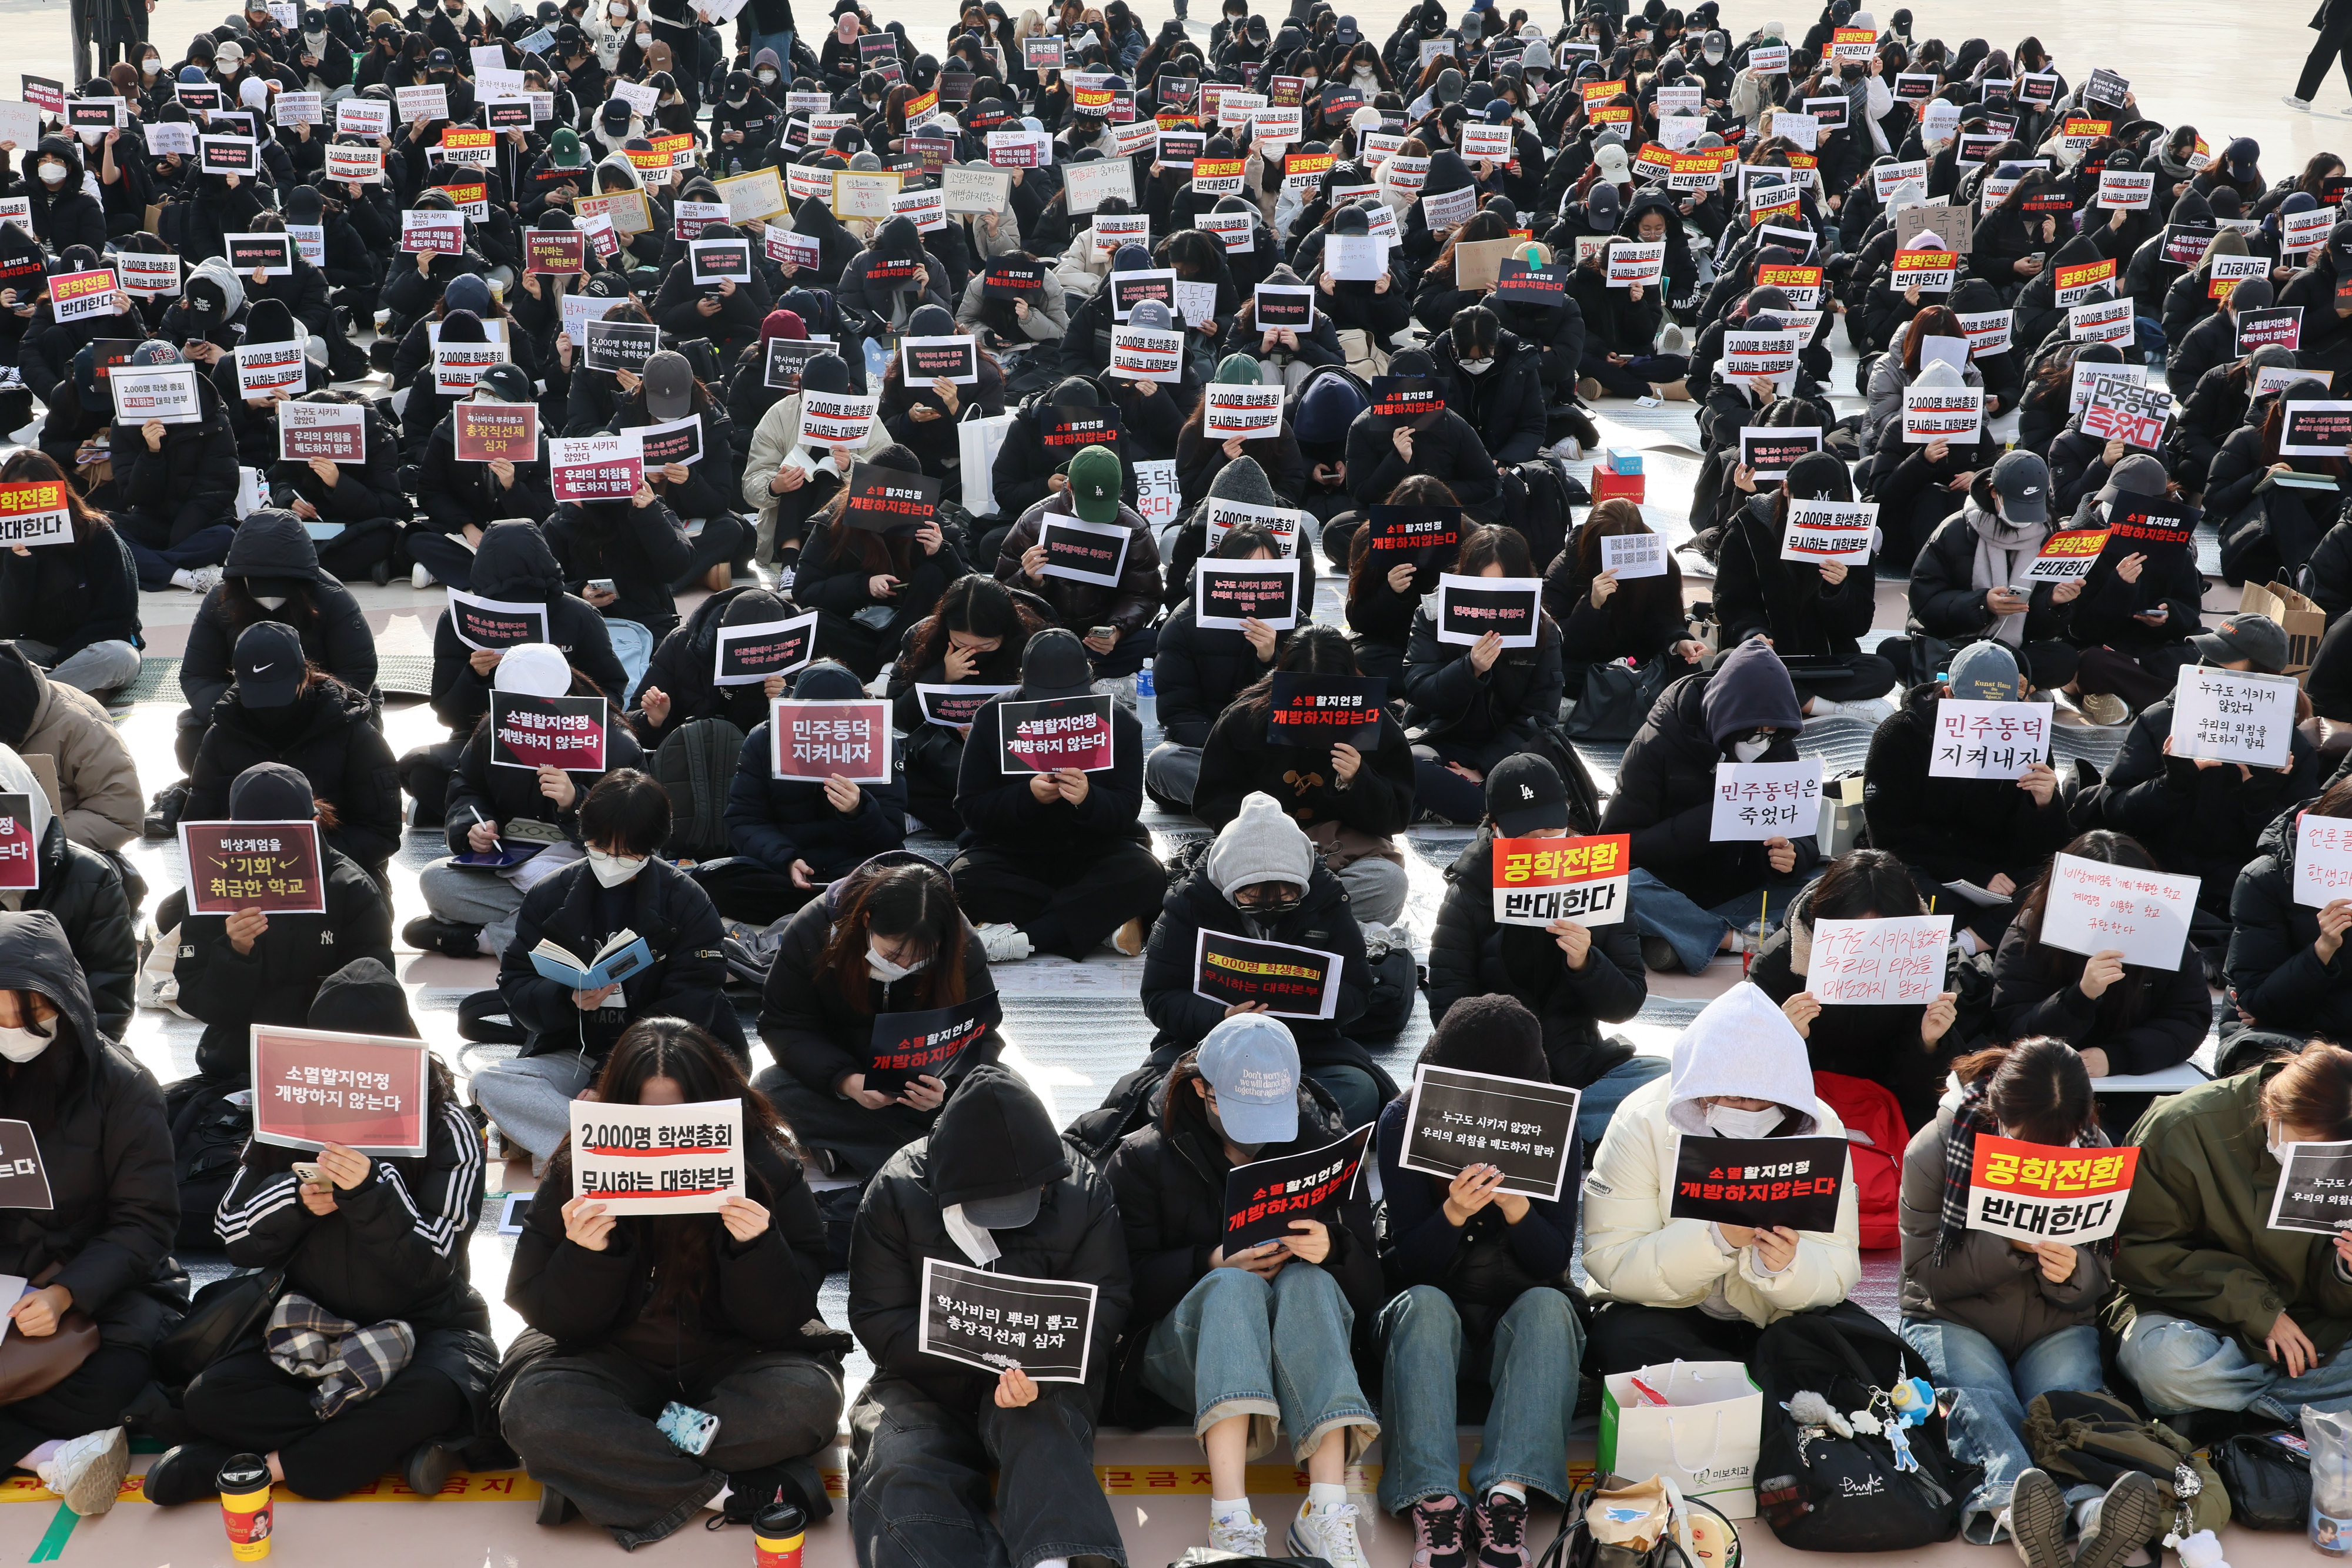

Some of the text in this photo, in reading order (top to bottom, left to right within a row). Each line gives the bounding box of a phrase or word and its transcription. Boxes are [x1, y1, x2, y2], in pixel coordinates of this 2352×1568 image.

[1836, 32, 1873, 42] 공학전환
[1835, 45, 1871, 55] 반대한다
[28, 82, 58, 95] 소멸할지언정
[477, 79, 520, 90] 공학전환반대
[907, 92, 936, 115] 공학전환
[1076, 93, 1111, 103] 공학전환
[1592, 110, 1629, 121] 공학전환
[1465, 131, 1509, 139] 2,000명 학생총회
[2067, 123, 2108, 135] 공학전환
[447, 134, 491, 146] 공학전환
[329, 151, 377, 162] 2,000명 학생총회
[448, 150, 490, 161] 반대한다
[1197, 163, 1241, 175] 공학전환
[1289, 157, 1332, 170] 공학전환
[1674, 159, 1719, 171] 공학전환
[950, 171, 995, 186] 소멸할지언정
[1197, 179, 1239, 190] 반대한다
[1672, 175, 1716, 186] 반대한다
[2103, 178, 2150, 188] 2,000명 학생총회
[410, 230, 454, 240] 우리의 외침을
[410, 239, 454, 249] 매도하지 말라
[532, 247, 563, 256] 무시하는
[122, 260, 176, 271] 2,000명 학생총회
[546, 258, 577, 268] 대학본부
[1898, 253, 1952, 268] 공학전환
[985, 276, 1041, 289] 개방하지않는다
[1512, 272, 1553, 280] 소멸할지언정
[1896, 272, 1949, 286] 반대한다
[2060, 263, 2110, 287] 공학전환
[57, 275, 111, 298] 공학전환
[1500, 280, 1563, 292] 개방하지않는다
[2246, 316, 2292, 330] 소멸할지언정
[592, 337, 650, 350] 2,000명 학생총회
[1116, 335, 1179, 351] 2,000명 학생총회
[151, 348, 175, 363] 143
[1114, 356, 1178, 371] 무시하는 대학본부
[1386, 390, 1434, 401] 소멸할지언정
[1908, 396, 1978, 409] 2,000명 학생총회
[2095, 380, 2174, 423] 민주동덕은
[293, 407, 340, 417] 누구도 시키지
[807, 400, 873, 417] 2,000명 학생총회
[1373, 399, 1445, 416] 개방하지않는다
[293, 416, 316, 426] 않았다
[1907, 419, 1977, 432] 무시하는 대학본부
[2086, 405, 2163, 448] 죽었다
[294, 431, 352, 443] 우리의 외침을
[466, 424, 524, 438] 총장직선제
[1044, 430, 1117, 446] 개방하지않는다
[295, 443, 352, 454] 매도하지 말라
[483, 440, 507, 452] 심자
[564, 441, 617, 451] 누구도 시키지
[564, 452, 590, 462] 않았다
[564, 467, 631, 480] 우리의 외침을
[566, 480, 632, 493] 매도하지 말라
[866, 486, 923, 500] 소멸할지언정
[1095, 486, 1104, 496] LA
[850, 496, 934, 517] 개방하지않는다
[1794, 511, 1872, 527] 2,000명 학생총회
[2126, 512, 2180, 527] 소멸할지언정
[1387, 521, 1442, 533] 소멸할지언정
[2110, 522, 2189, 543] 개방하지않는다
[1372, 532, 1457, 550] 개방하지않는다
[1789, 536, 1868, 551] 무시하는 대학본부
[2045, 533, 2106, 555] 공학전환
[2029, 558, 2094, 577] 반대한다
[1454, 606, 1525, 619] 민주동덕은 죽었다
[2198, 681, 2276, 702] 누구도 시키지
[1292, 694, 1363, 707] 소멸할지언정
[2219, 699, 2253, 715] 않았다
[506, 710, 589, 730] 소멸할지언정
[1272, 708, 1379, 724] 개방하지않는다
[792, 718, 870, 741] 민주동덕
[1016, 713, 1097, 735] 소멸할지언정
[1945, 714, 2043, 743] 민주동덕
[2199, 718, 2267, 736] 우리의 외침을
[497, 728, 599, 750] 개방하지 않는다
[1007, 731, 1107, 754] 개방하지 않는다
[793, 741, 871, 764] 지켜내자
[1521, 784, 1534, 800] LA
[1720, 778, 1819, 803] 민주동덕은
[1738, 804, 1798, 826] 죽었다
[220, 838, 281, 852] 비상계엄을
[1504, 842, 1619, 882] 공학전환
[211, 878, 306, 898] 취급한 학교
[1505, 884, 1616, 920] 반대한다
[1207, 952, 1320, 980] 2,000명 학생총회
[1820, 956, 1934, 979] 우리의 외침을
[1204, 969, 1319, 996] 무시하는 대학본부
[286, 1066, 390, 1089] 소멸할지언정
[1243, 1069, 1281, 1080] Don't worry
[275, 1084, 401, 1112] 개방하지 않는다
[1235, 1085, 1282, 1098] together again
[582, 1124, 732, 1151] 2,000명 학생총회
[1709, 1161, 1810, 1179] 소멸할지언정
[1984, 1152, 2124, 1191] 공학전환
[582, 1167, 734, 1195] 무시하는 대학본부
[1252, 1159, 1344, 1201] 소멸할지언정
[1588, 1178, 1612, 1194] Discovery
[1228, 1160, 1358, 1232] 개방하지않는다
[1680, 1178, 1836, 1202] 개방하지않는다
[1981, 1196, 2113, 1236] 반대한다
[937, 1295, 1079, 1332] 학사비리 뿌리 뽑고
[946, 1315, 1065, 1349] 총장직선제 심자
